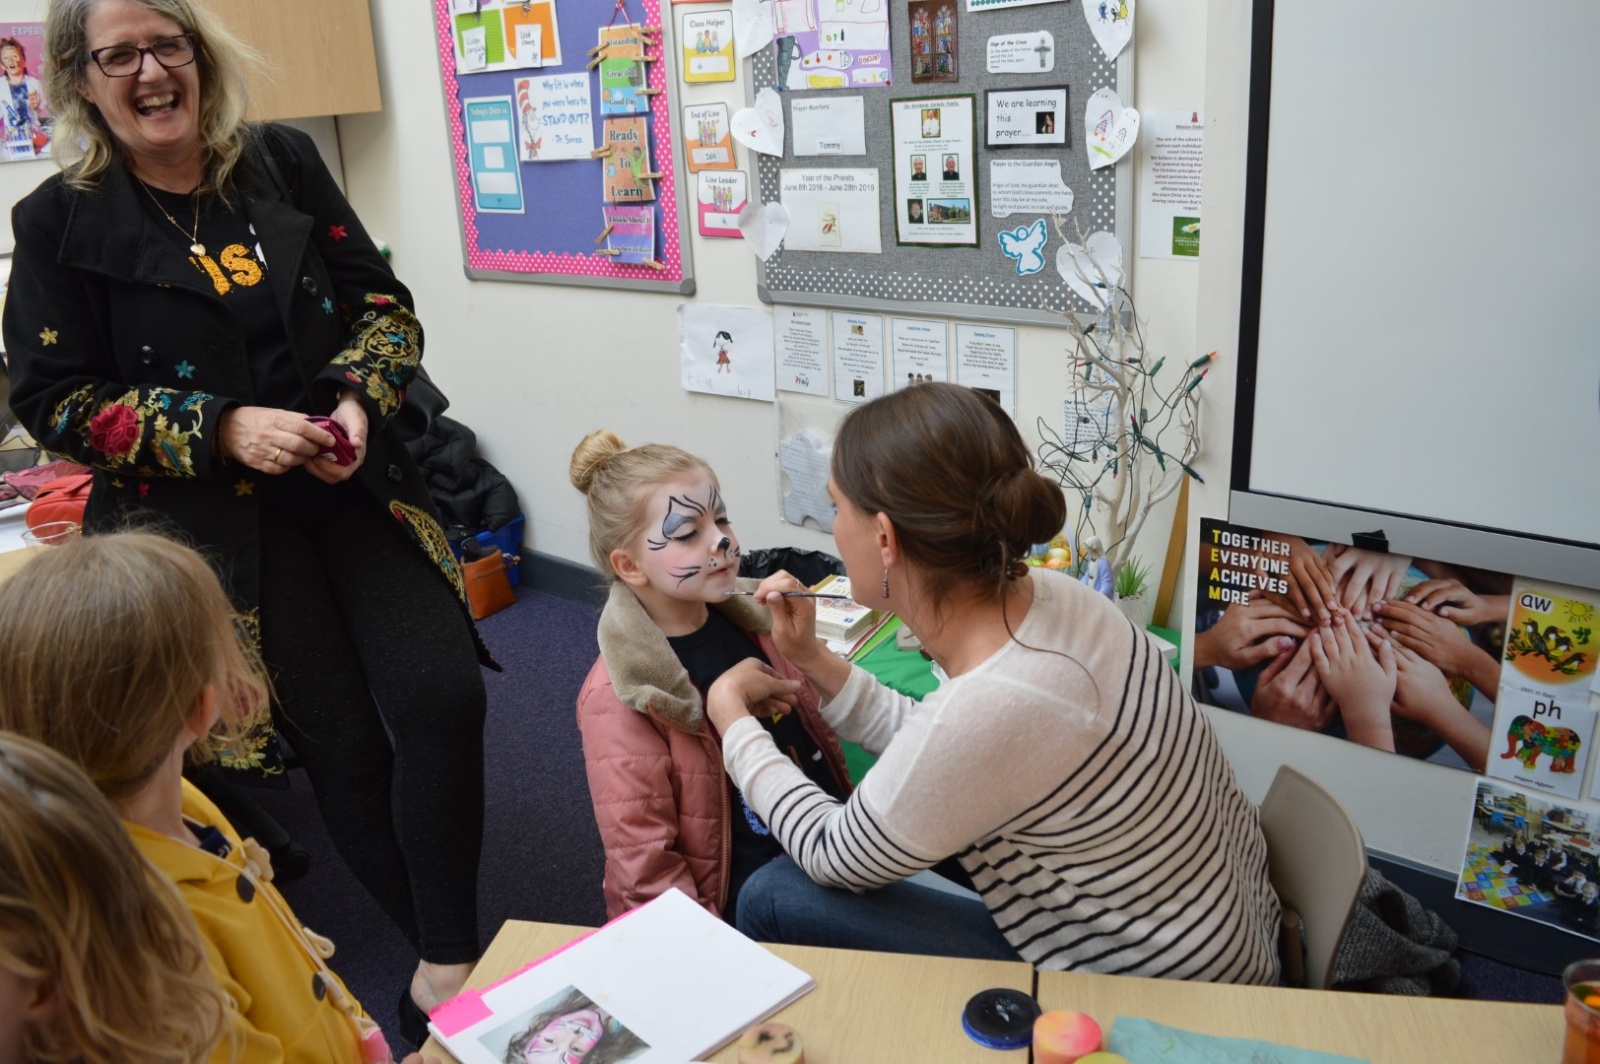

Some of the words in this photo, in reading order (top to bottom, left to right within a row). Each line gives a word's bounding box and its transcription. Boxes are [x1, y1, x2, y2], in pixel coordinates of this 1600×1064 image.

[706, 19, 726, 28] Helper
[606, 38, 638, 46] utstanding
[996, 100, 1009, 108] We
[1026, 98, 1056, 109] learning
[542, 113, 566, 126] STAND
[569, 112, 590, 124] OUT?
[702, 110, 707, 120] of
[996, 114, 1011, 122] this
[565, 134, 582, 144] Seuss
[610, 128, 638, 144] Ready
[819, 142, 840, 150] Tommy
[618, 158, 630, 168] To
[612, 186, 644, 197] Learn
[1212, 529, 1290, 557] TOGETHER
[1211, 548, 1290, 575] EVERYONE
[1210, 567, 1288, 594] ACHIEVES
[1209, 586, 1250, 606] MORE
[1521, 594, 1552, 612] aw
[1533, 700, 1561, 720] ph
